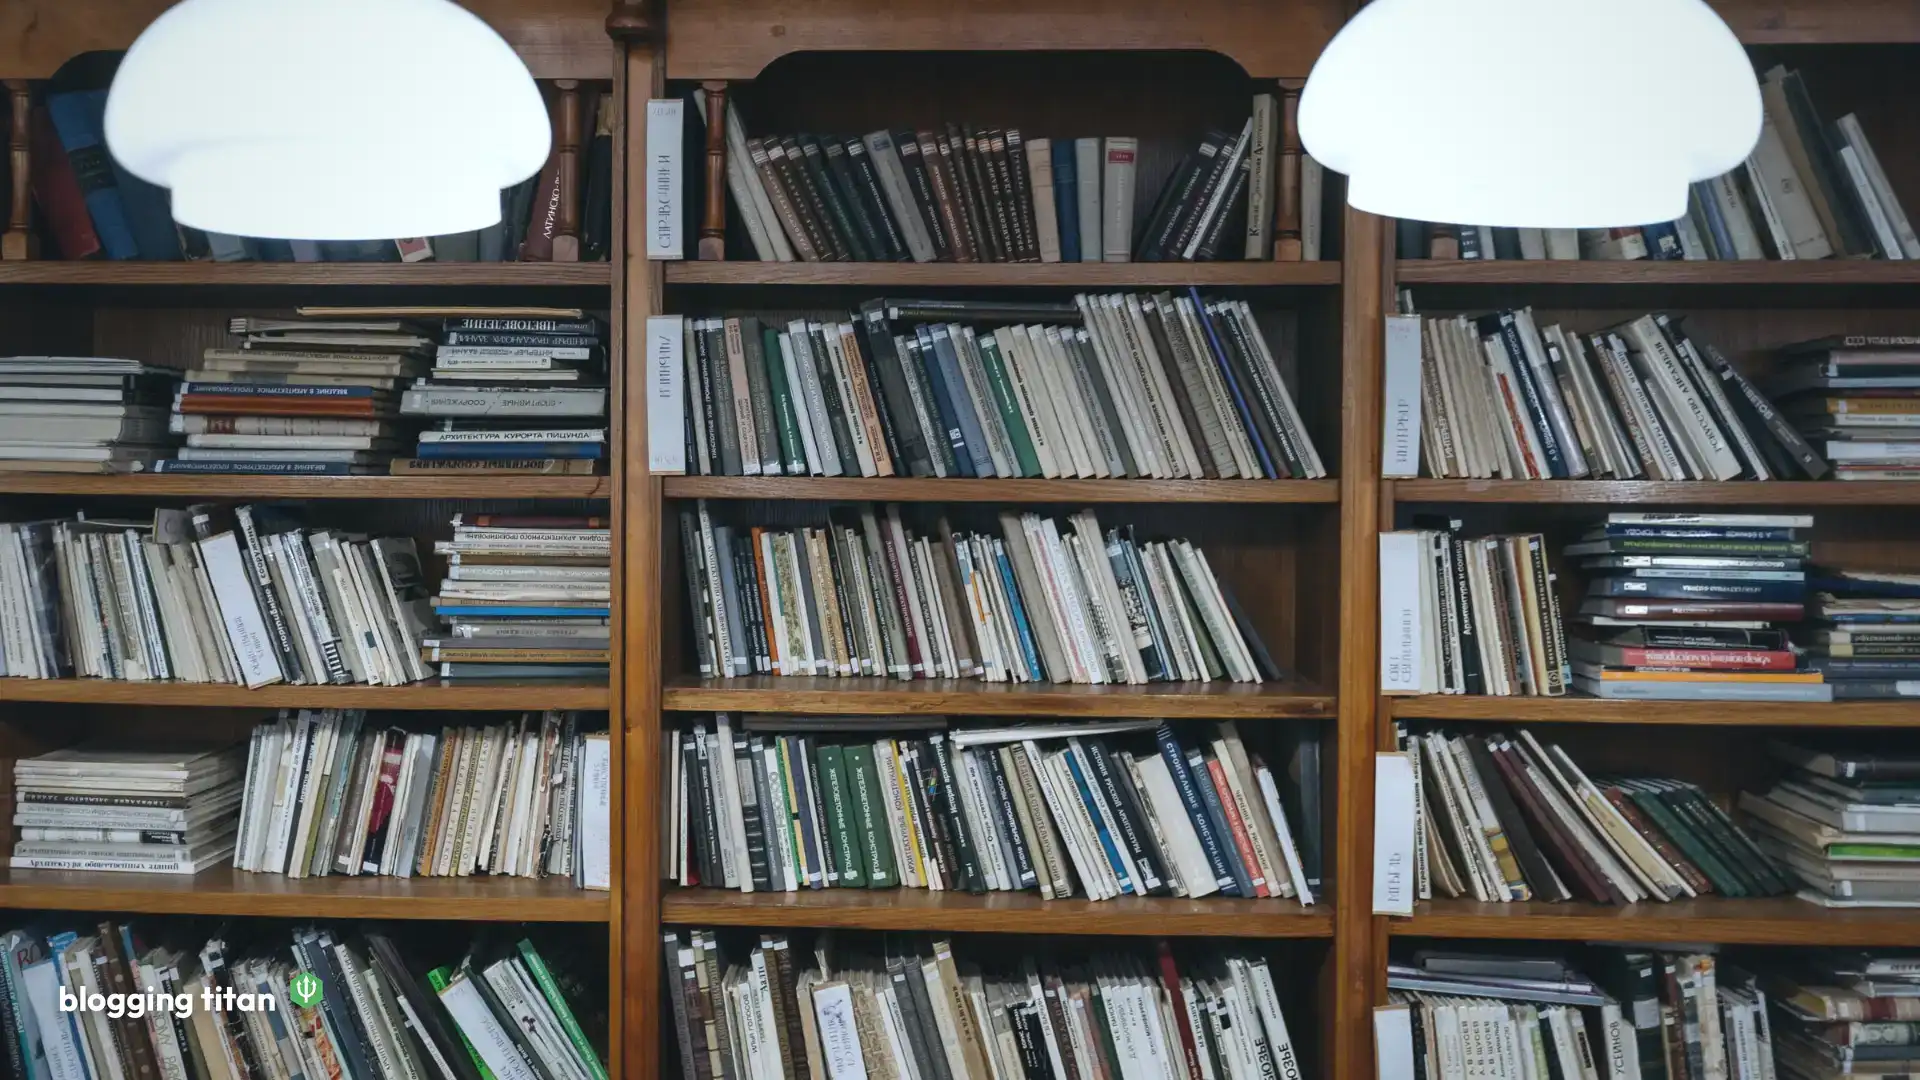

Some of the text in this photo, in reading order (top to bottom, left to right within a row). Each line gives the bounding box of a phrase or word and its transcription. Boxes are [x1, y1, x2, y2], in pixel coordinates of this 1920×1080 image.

[461, 318, 557, 331] ЦВЕТОВЕДЕНИЕ
[1653, 341, 1689, 394] АНСАМБЛЯ
[430, 399, 556, 407] СПОРТИВНЫЕ СООРУЖЕНИЯ
[439, 432, 590, 441] АРХИТЕКТУРА КУРОРТА ПИЦУНДА
[707, 420, 717, 458] ТРАНСПОРТНЫЕ
[1438, 414, 1453, 458] ИНТЕРЬЕР
[1453, 539, 1464, 572] солнце
[1458, 581, 1471, 635] Архитектура
[885, 756, 902, 811] КОНСТРУКЦИИ
[995, 774, 1008, 800] ОСНОВЫ
[1016, 756, 1034, 794] ВВЕДЕНИЕ
[855, 766, 873, 828] ЖЕЛЕЗОБЕТОННЫЕ
[945, 784, 957, 813] История
[1090, 745, 1143, 853] ИСТОРИЯ РУССКОЙ АРХИТЕКТУРЫ
[1165, 741, 1226, 875] СТРОИТЕЛЬНЫЕ КОНСТРУКЦИИ
[828, 767, 855, 879] ЖЕЛЕЗОБЕТОННЫЕ КОНСТРУКЦ
[1250, 831, 1269, 871] РИСОВАНИЕ
[742, 993, 757, 1053] ИЛЬЯ ГОЛОСОВ
[1461, 1020, 1471, 1055] ЩУСЕВ
[1473, 1020, 1482, 1055] ЩУСЕВ
